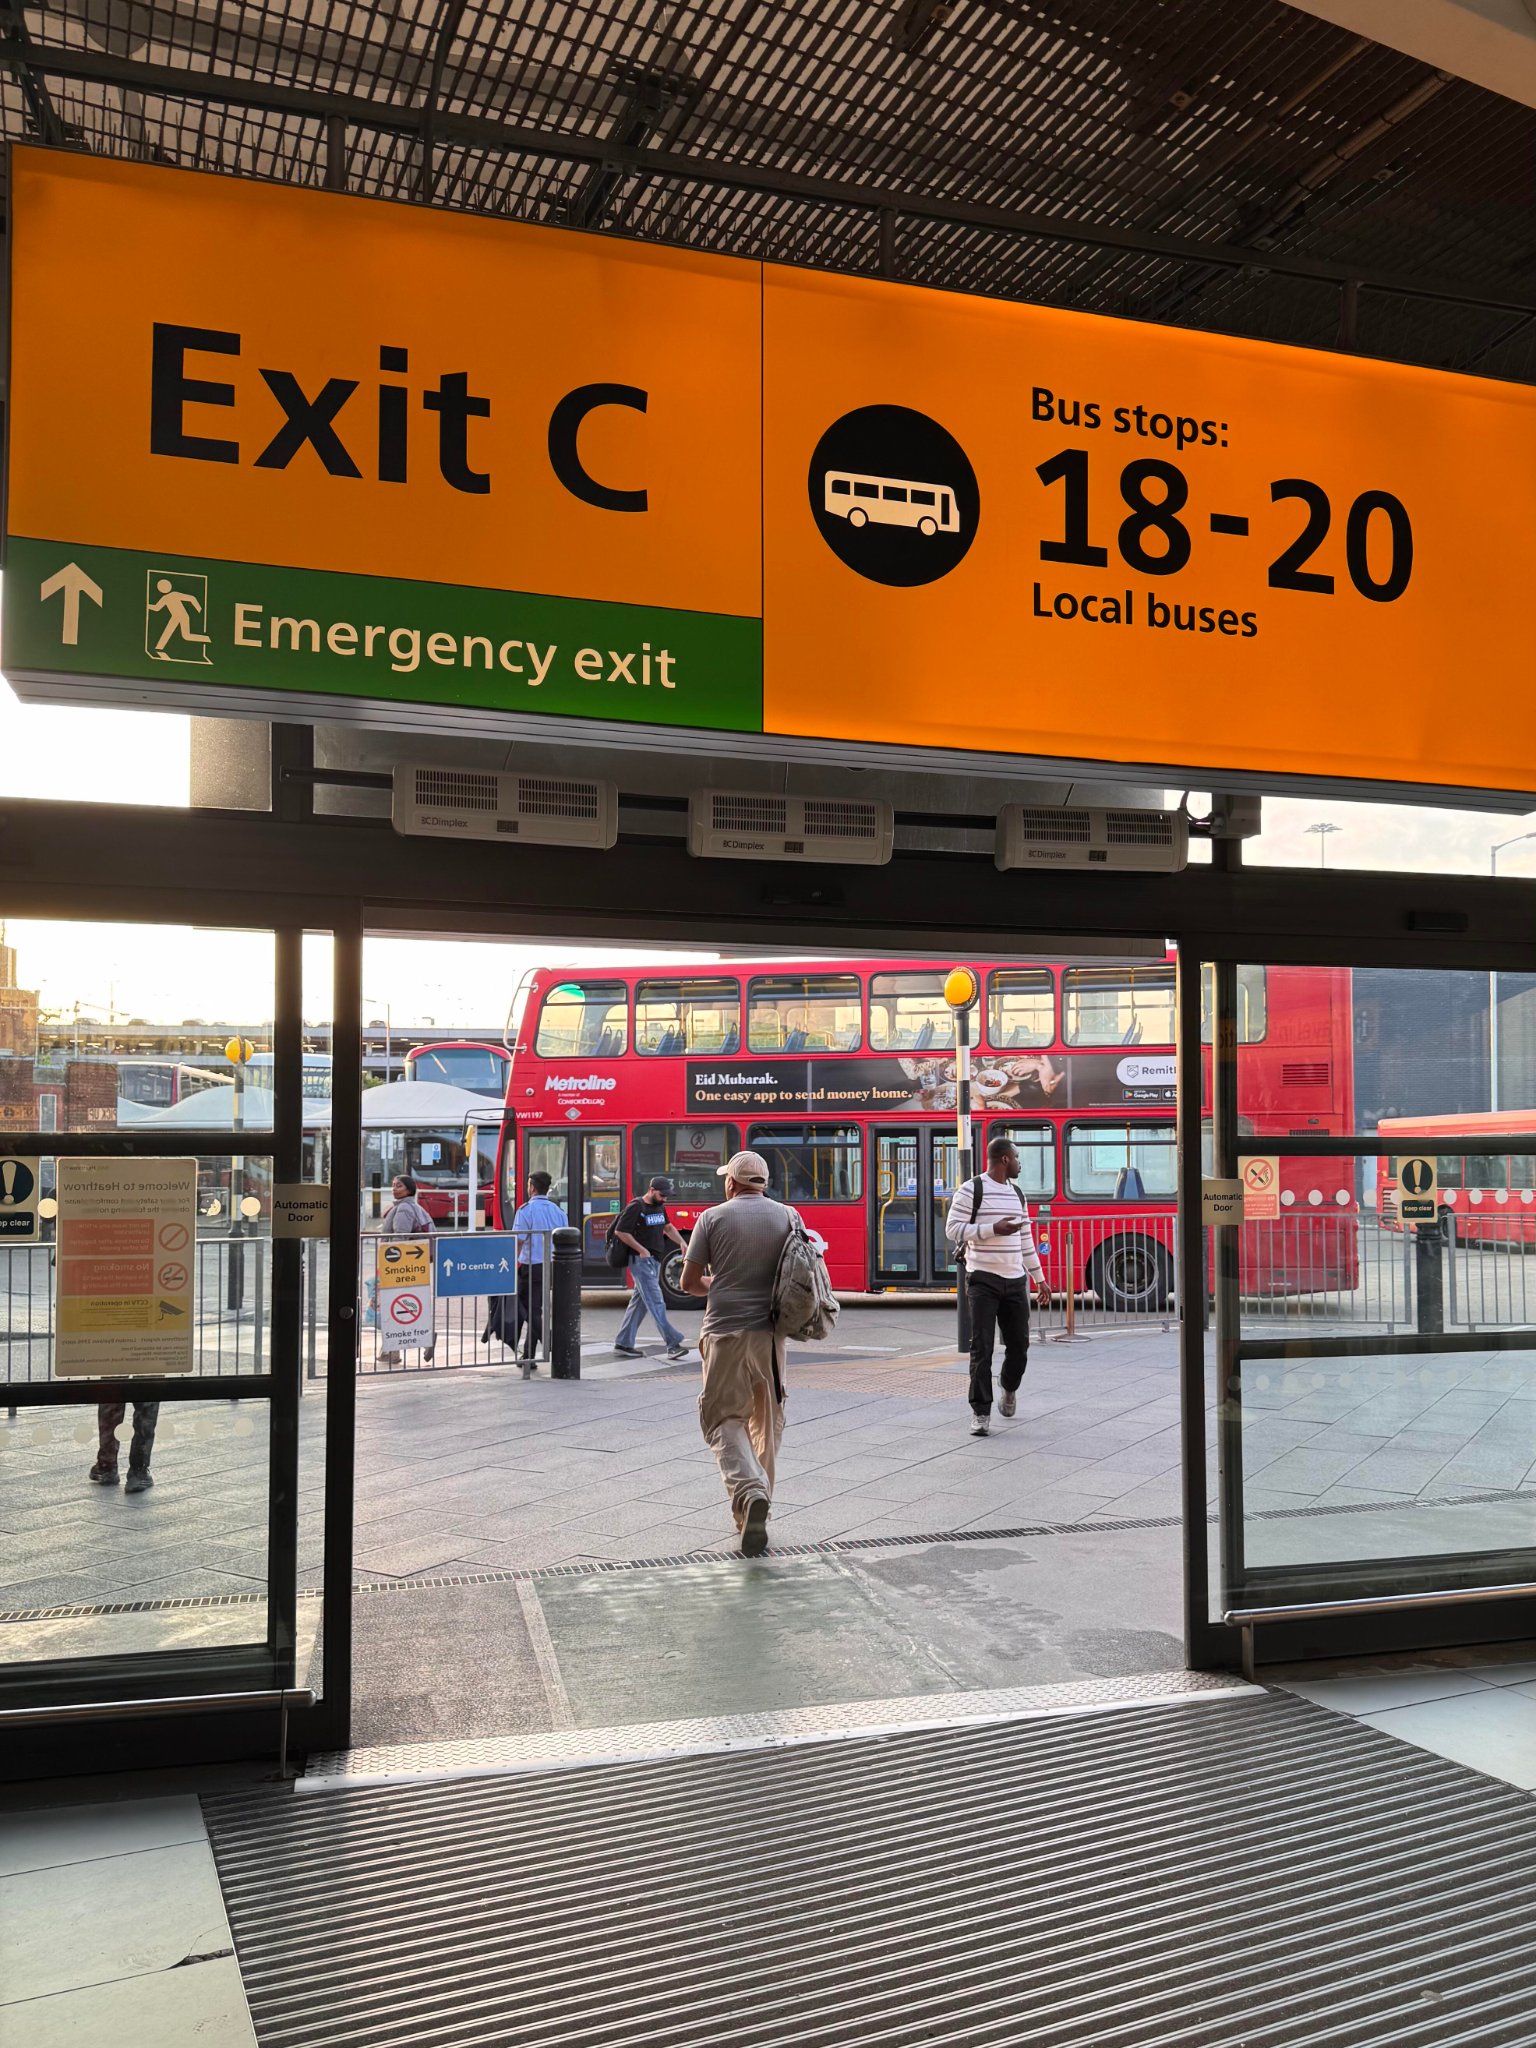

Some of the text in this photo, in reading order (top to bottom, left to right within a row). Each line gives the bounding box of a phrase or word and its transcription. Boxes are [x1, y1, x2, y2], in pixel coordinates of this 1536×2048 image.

[150, 322, 648, 513] Exit C
[1031, 386, 1229, 450] Bus stops:
[1033, 582, 1259, 638] Local buses
[234, 604, 677, 689] Emergency exit
[1142, 1066, 1177, 1074] Remitl
[544, 1074, 617, 1091] Metroline
[695, 1072, 778, 1086] Eid Mubarak.
[695, 1086, 912, 1103] One easy app to send money home.
[515, 1111, 543, 1119] VW1197
[678, 1180, 712, 1189] Uxbridge
[1203, 1193, 1243, 1201] Automatic
[274, 1200, 329, 1209] Automatic
[1213, 1203, 1233, 1212] Door
[287, 1213, 314, 1222] Door
[10, 1219, 31, 1227] clear
[384, 1264, 426, 1275] Smoking
[457, 1262, 495, 1271] ID centre
[395, 1275, 416, 1283] area
[385, 1328, 429, 1339] Smoke free
